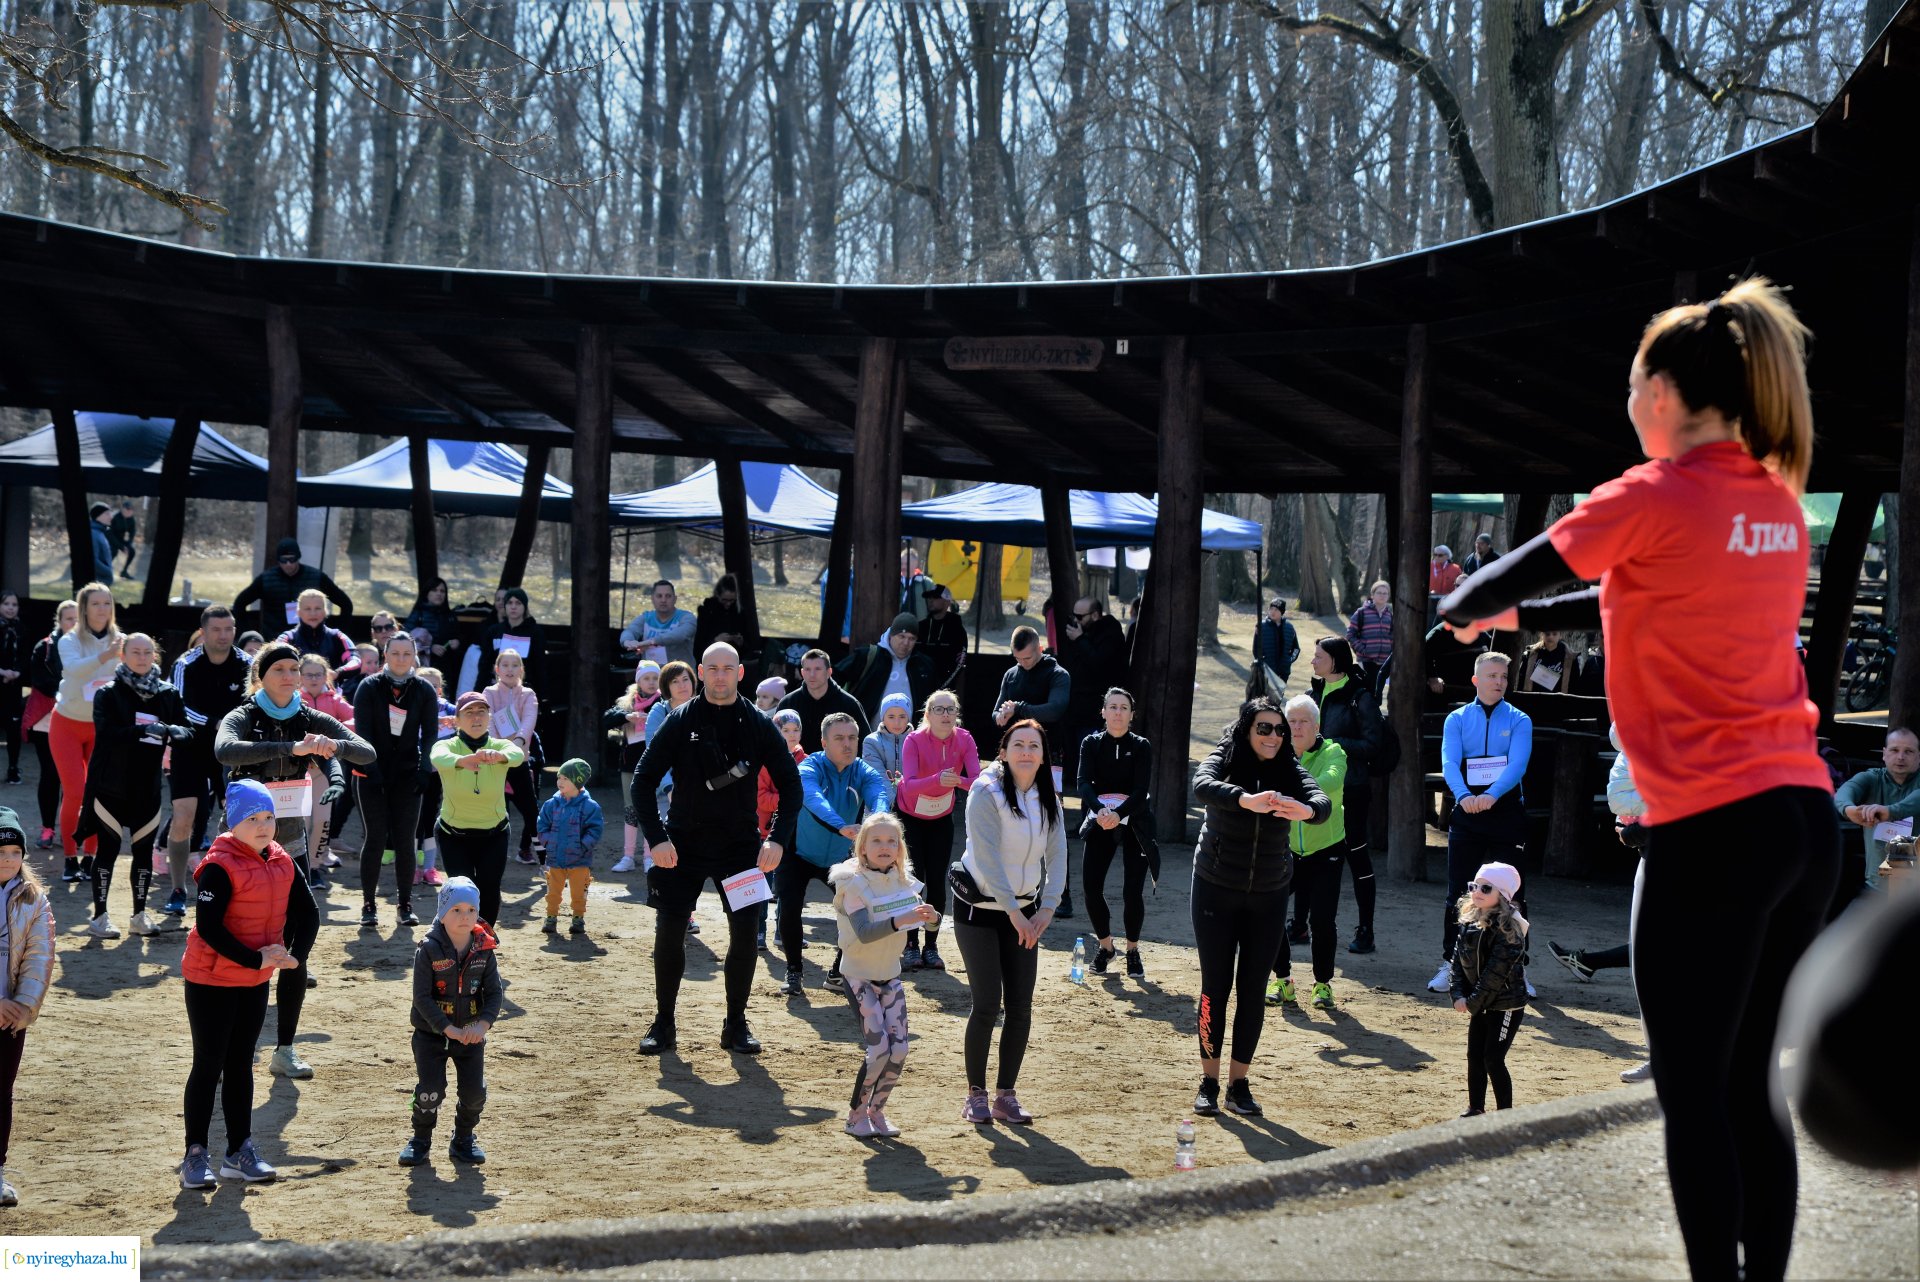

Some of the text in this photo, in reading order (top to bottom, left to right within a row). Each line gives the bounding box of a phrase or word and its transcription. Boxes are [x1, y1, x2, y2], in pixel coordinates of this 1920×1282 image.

[1727, 512, 1798, 557] ÁJIKA
[279, 794, 292, 803] 413
[743, 888, 756, 897] 414
